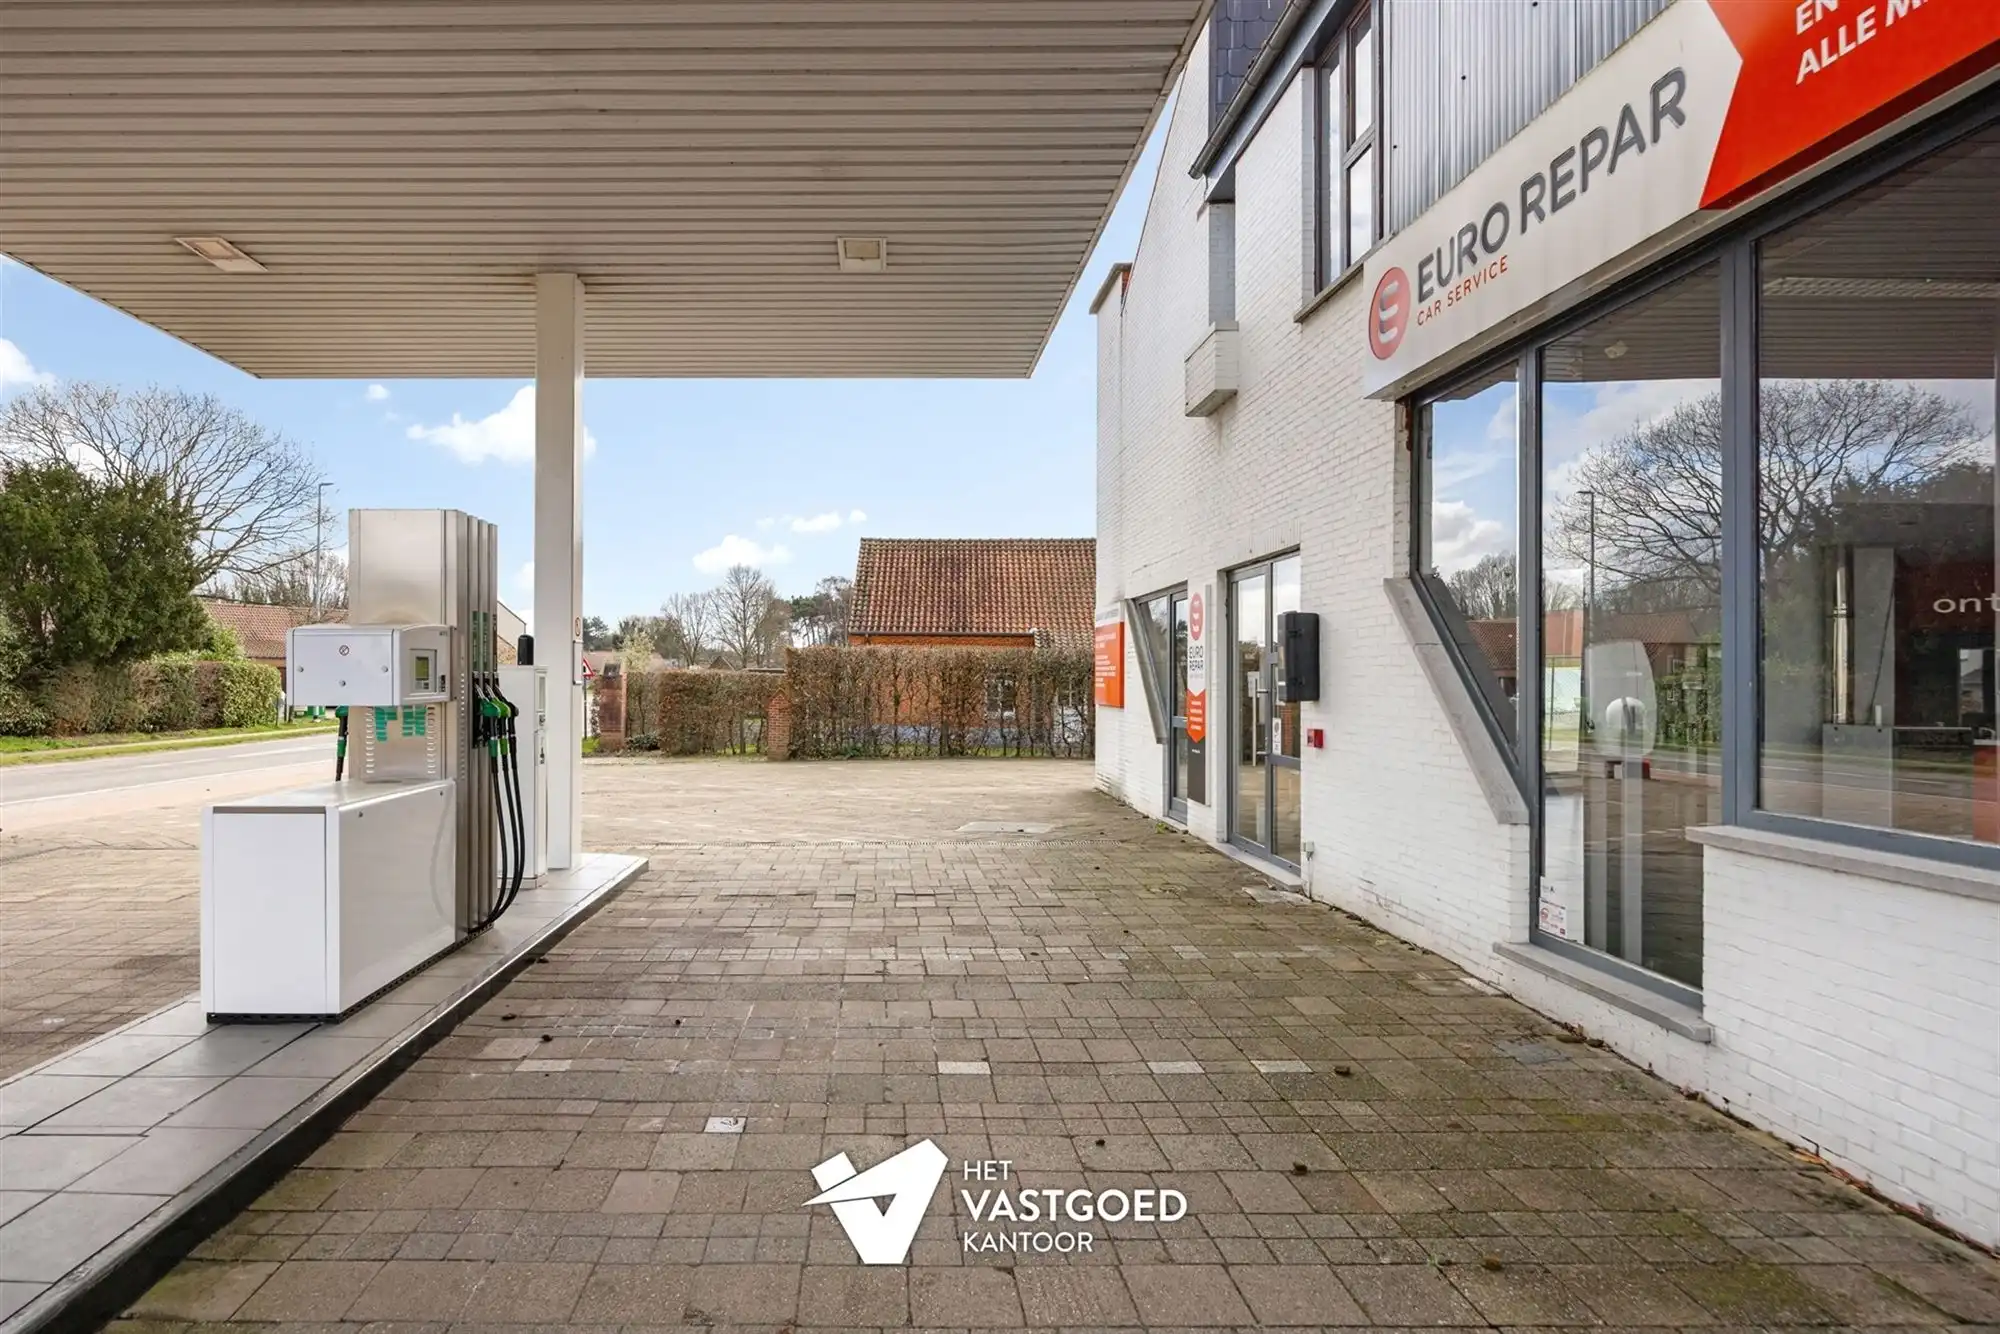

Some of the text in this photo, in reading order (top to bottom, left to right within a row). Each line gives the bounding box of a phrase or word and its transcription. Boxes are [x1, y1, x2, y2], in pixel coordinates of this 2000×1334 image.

[1796, 0, 1839, 35] EN
[1796, 5, 1877, 85] ALLE
[1417, 66, 1687, 304] EURO REPAR
[1416, 255, 1508, 326] CAR SERVICE
